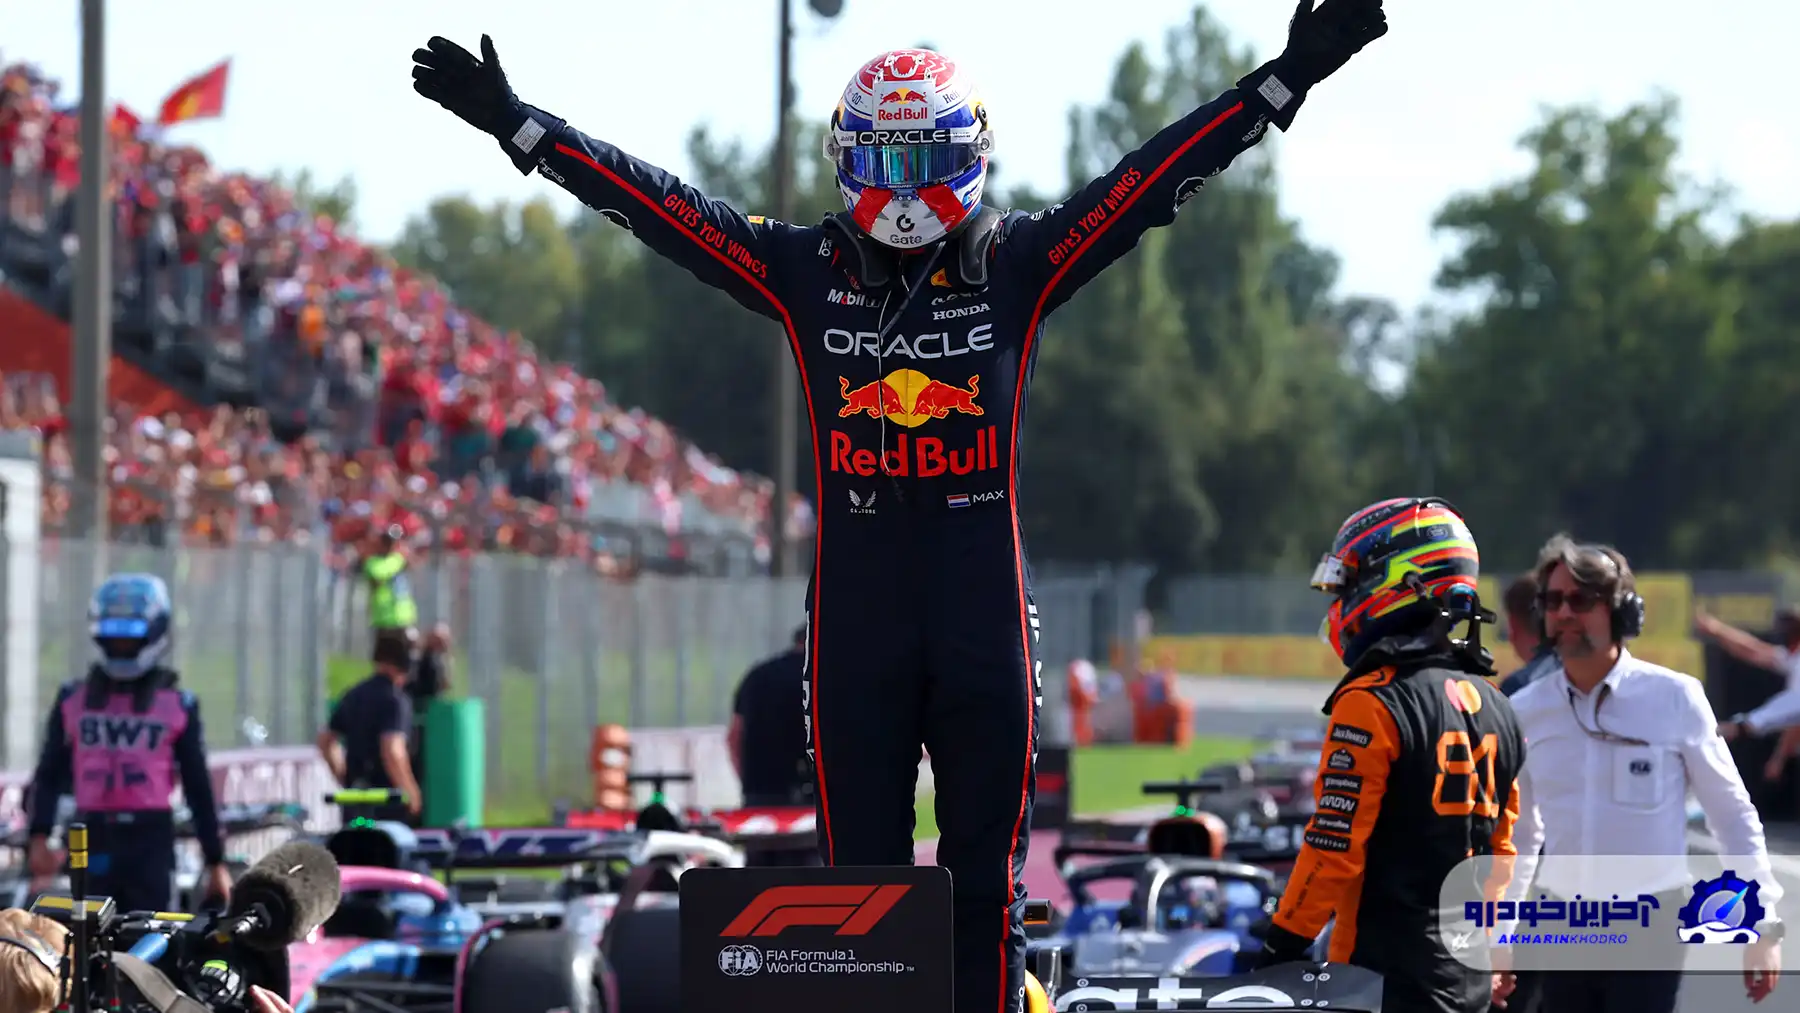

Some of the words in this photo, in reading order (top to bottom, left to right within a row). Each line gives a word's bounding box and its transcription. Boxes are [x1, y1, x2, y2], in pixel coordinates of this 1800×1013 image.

[878, 109, 901, 121] Red
[903, 107, 928, 120] Bull
[859, 130, 946, 145] ORACLE
[1047, 226, 1082, 265] GIVES
[1078, 204, 1107, 233] YOU
[1104, 166, 1142, 212] WINGS
[664, 194, 702, 228] GIVES
[699, 221, 727, 248] YOU
[727, 239, 768, 279] WINGS
[890, 234, 923, 245] Gate
[827, 288, 865, 307] Mobil
[932, 303, 991, 320] HONDA
[823, 323, 994, 359] ORACLE
[830, 430, 908, 477] Red
[916, 425, 998, 478] Bull
[973, 490, 1004, 503] MAX
[79, 715, 164, 752] BWT
[1432, 731, 1500, 817] 81
[766, 950, 788, 961] FIA
[791, 950, 846, 961] Formula
[766, 962, 806, 973] World
[809, 961, 905, 974] Championship
